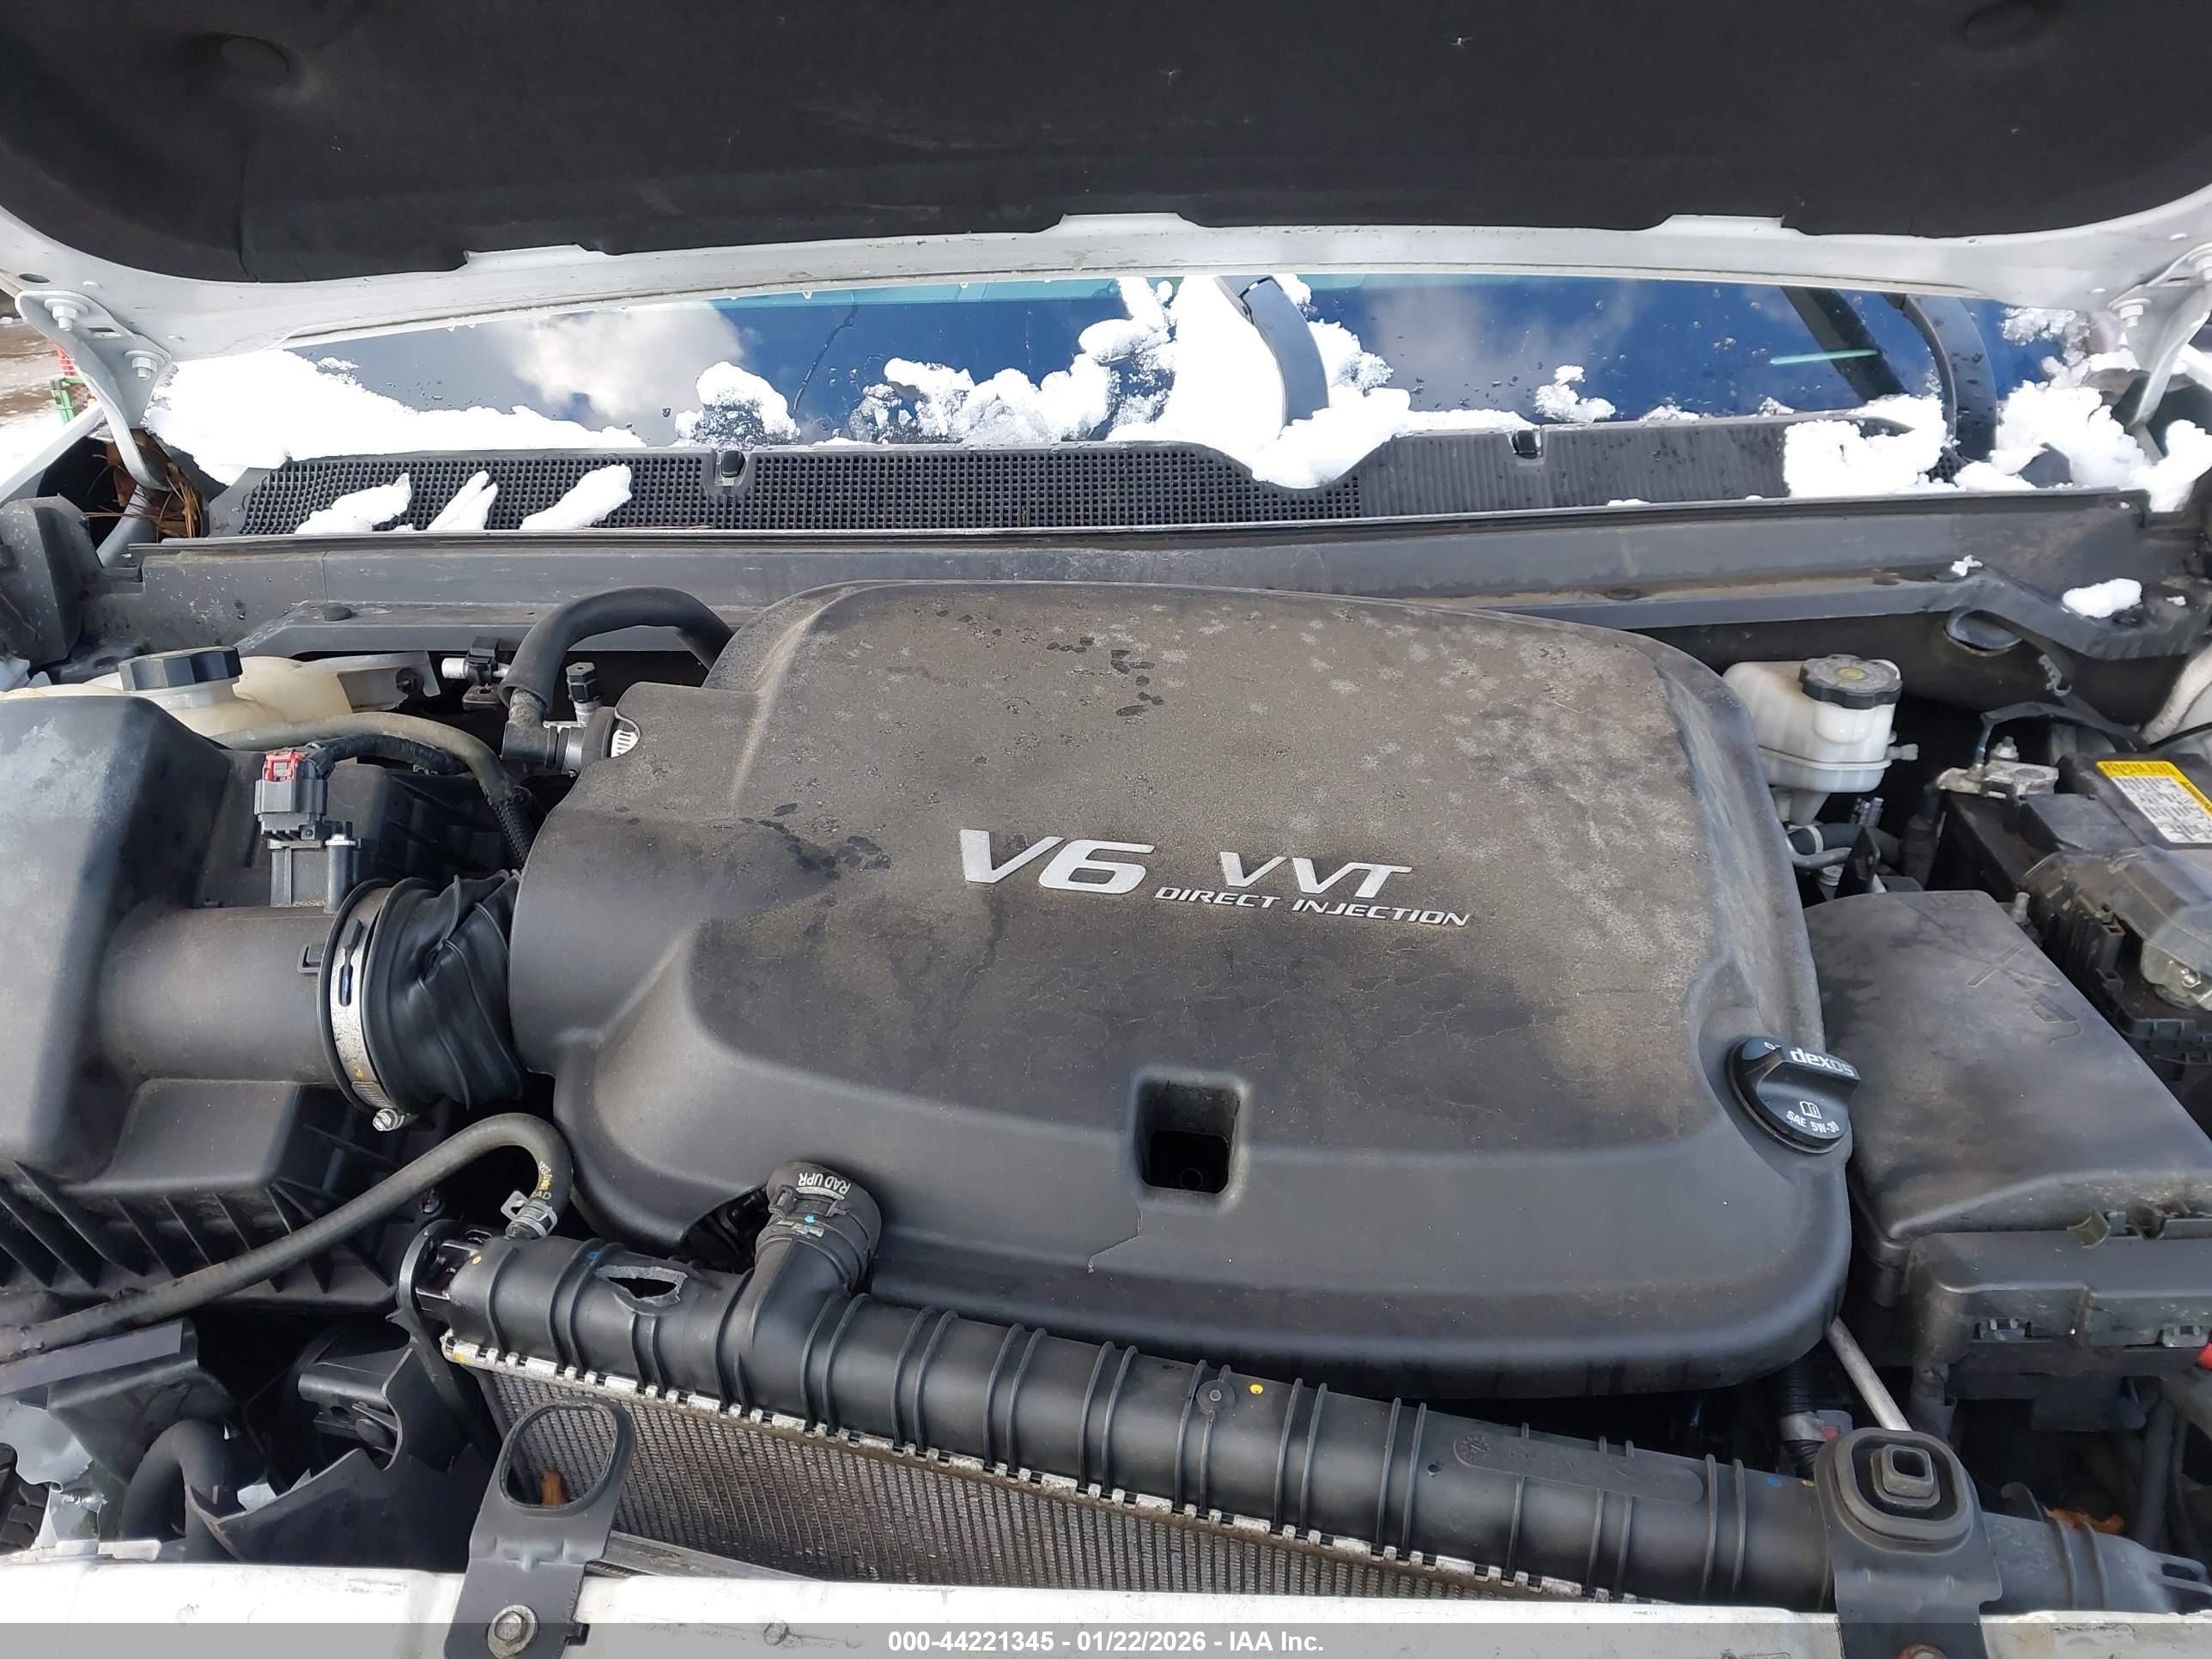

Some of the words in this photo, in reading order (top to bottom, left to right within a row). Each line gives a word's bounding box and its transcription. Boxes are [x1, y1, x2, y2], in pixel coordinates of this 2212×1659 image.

[960, 829, 1155, 894] V6
[1219, 851, 1413, 898] VVT
[1154, 886, 1281, 908] DIRECT
[1291, 899, 1471, 927] INJECTION
[1790, 1048, 1856, 1076] dexos
[1786, 1110, 1807, 1128] SAE
[1810, 1121, 1839, 1133] 5W-30
[798, 1172, 824, 1186] UPR
[823, 1175, 852, 1195] RAD
